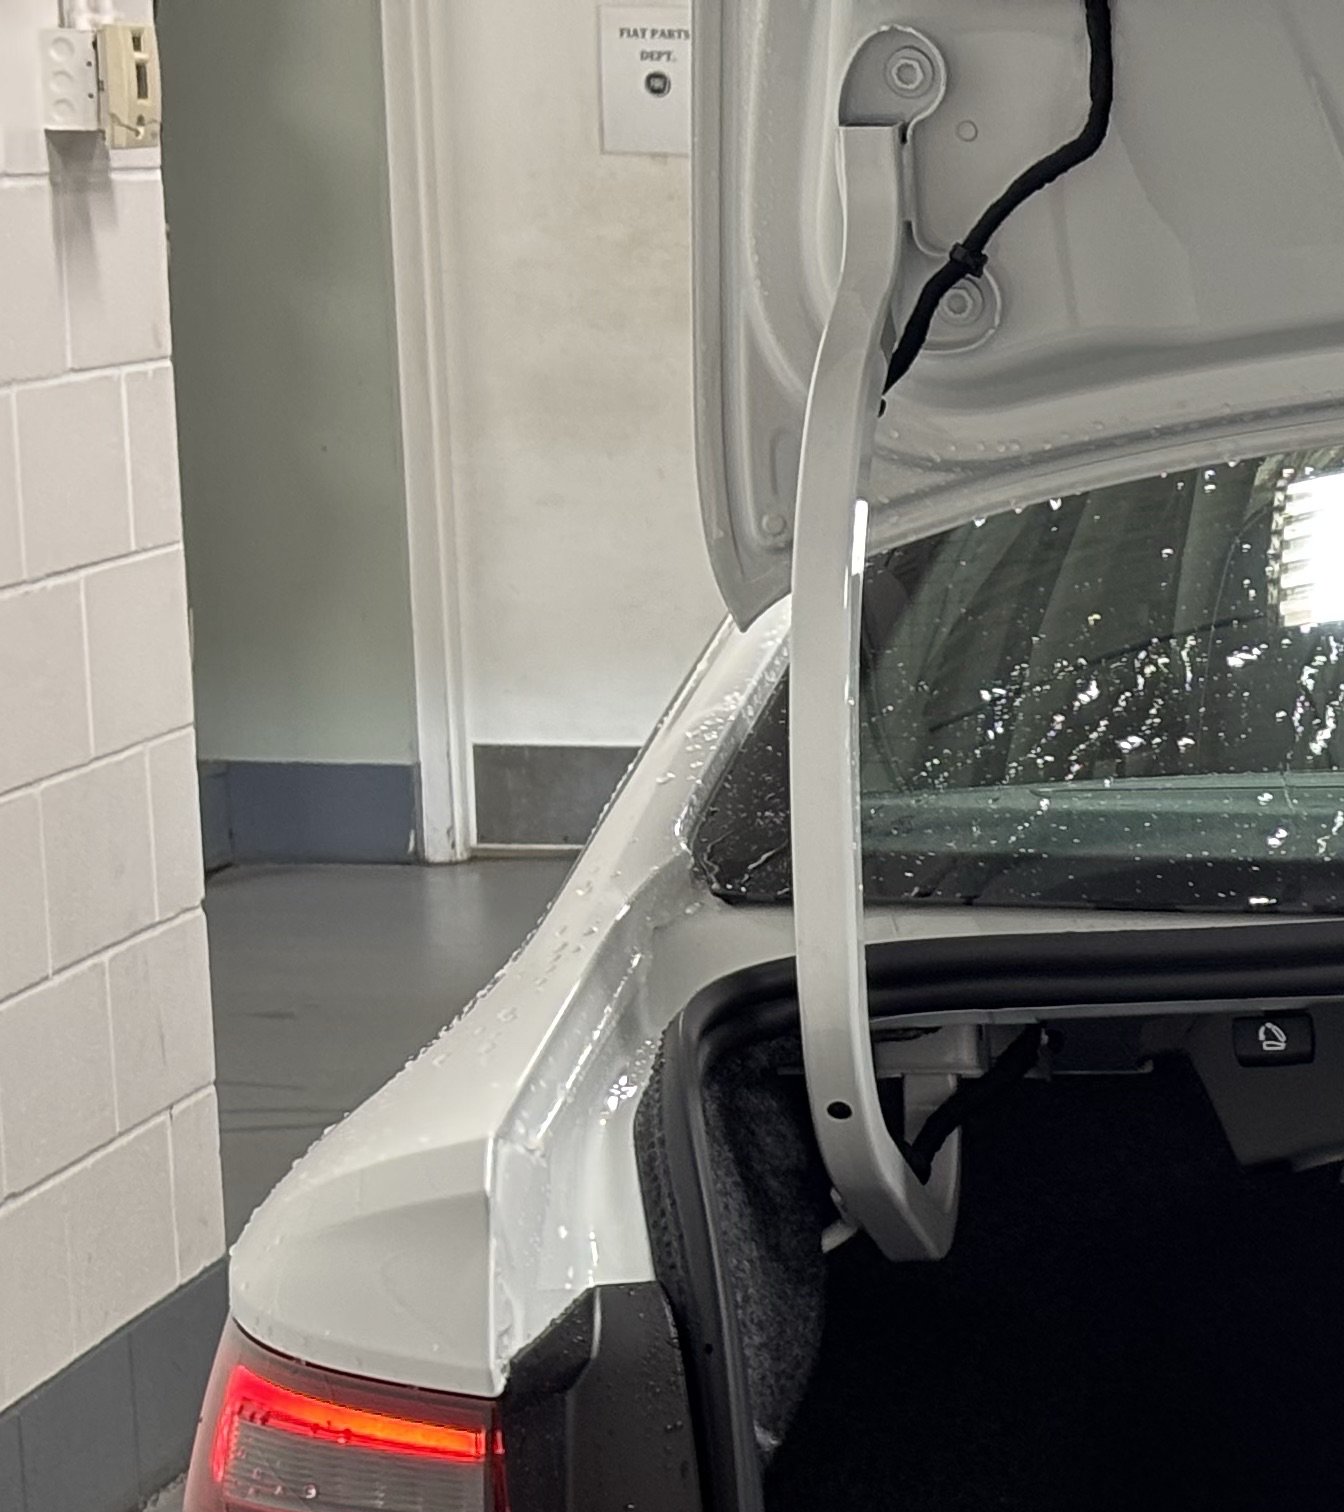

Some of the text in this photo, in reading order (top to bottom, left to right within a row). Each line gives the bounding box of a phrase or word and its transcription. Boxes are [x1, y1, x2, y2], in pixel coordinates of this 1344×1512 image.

[619, 27, 690, 40] FIAT PARTS
[640, 50, 677, 62] DEPT.
